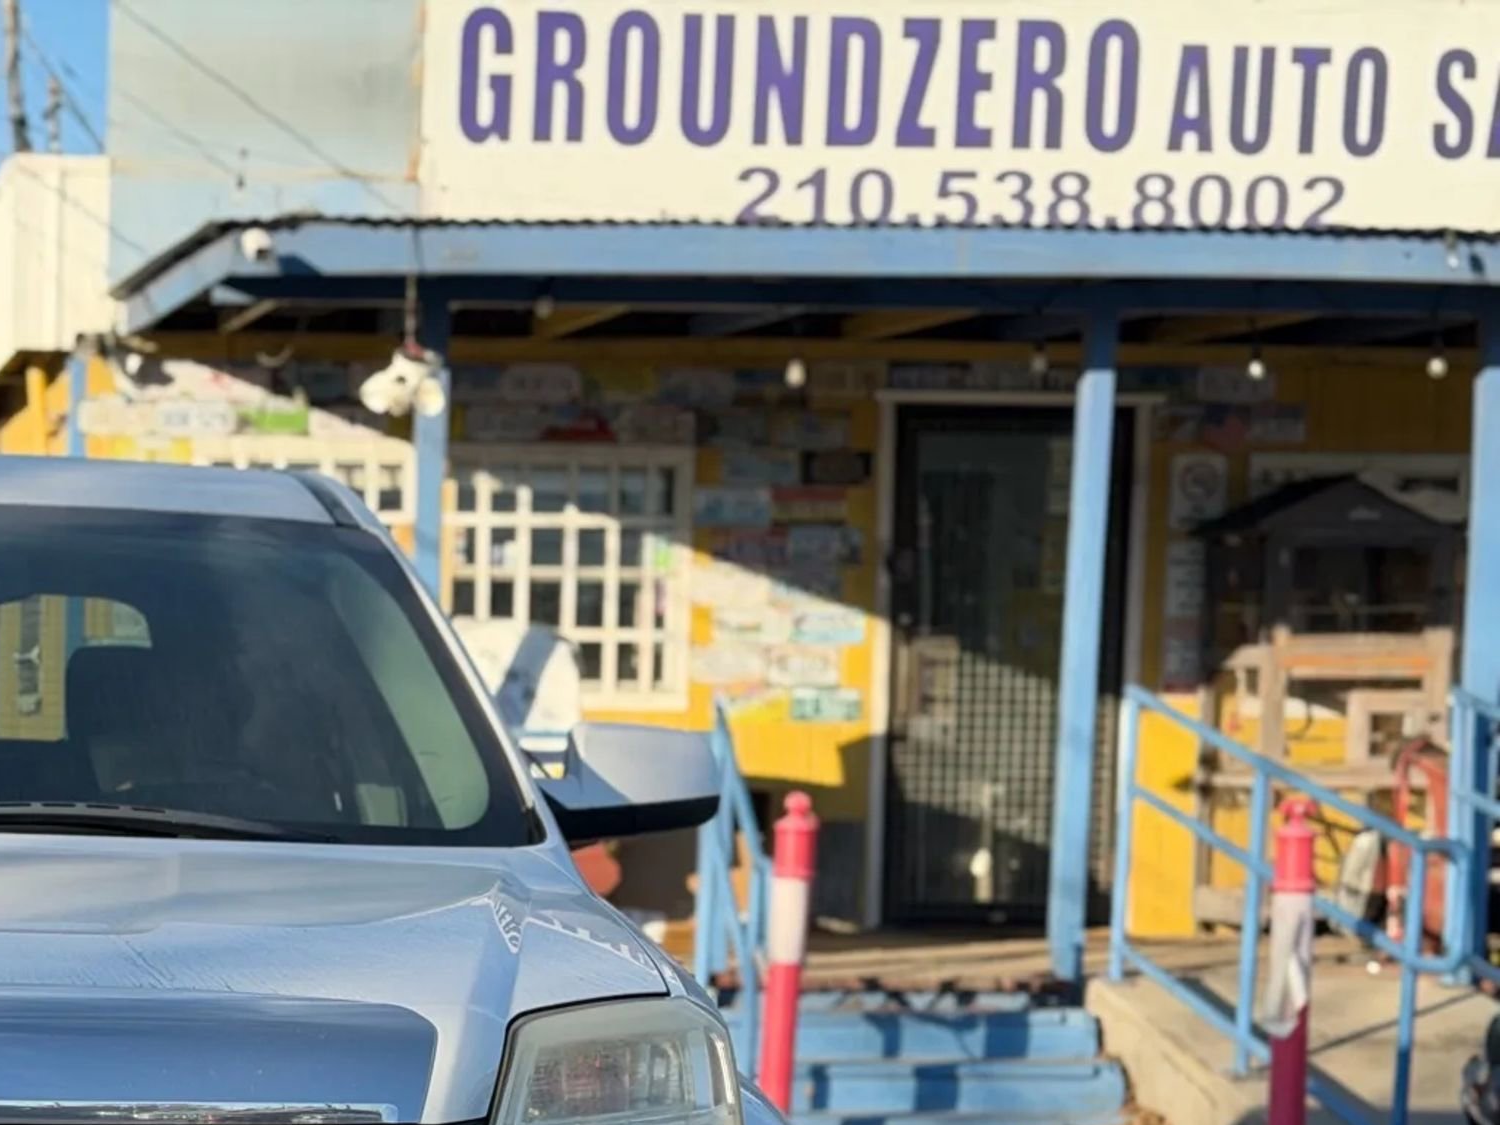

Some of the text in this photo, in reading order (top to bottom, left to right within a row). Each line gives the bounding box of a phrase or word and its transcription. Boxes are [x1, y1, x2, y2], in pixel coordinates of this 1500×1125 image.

[459, 7, 1140, 153] GROUNDZERO
[1167, 45, 1388, 157] AUTO
[736, 167, 1345, 228] 210.538.8002
